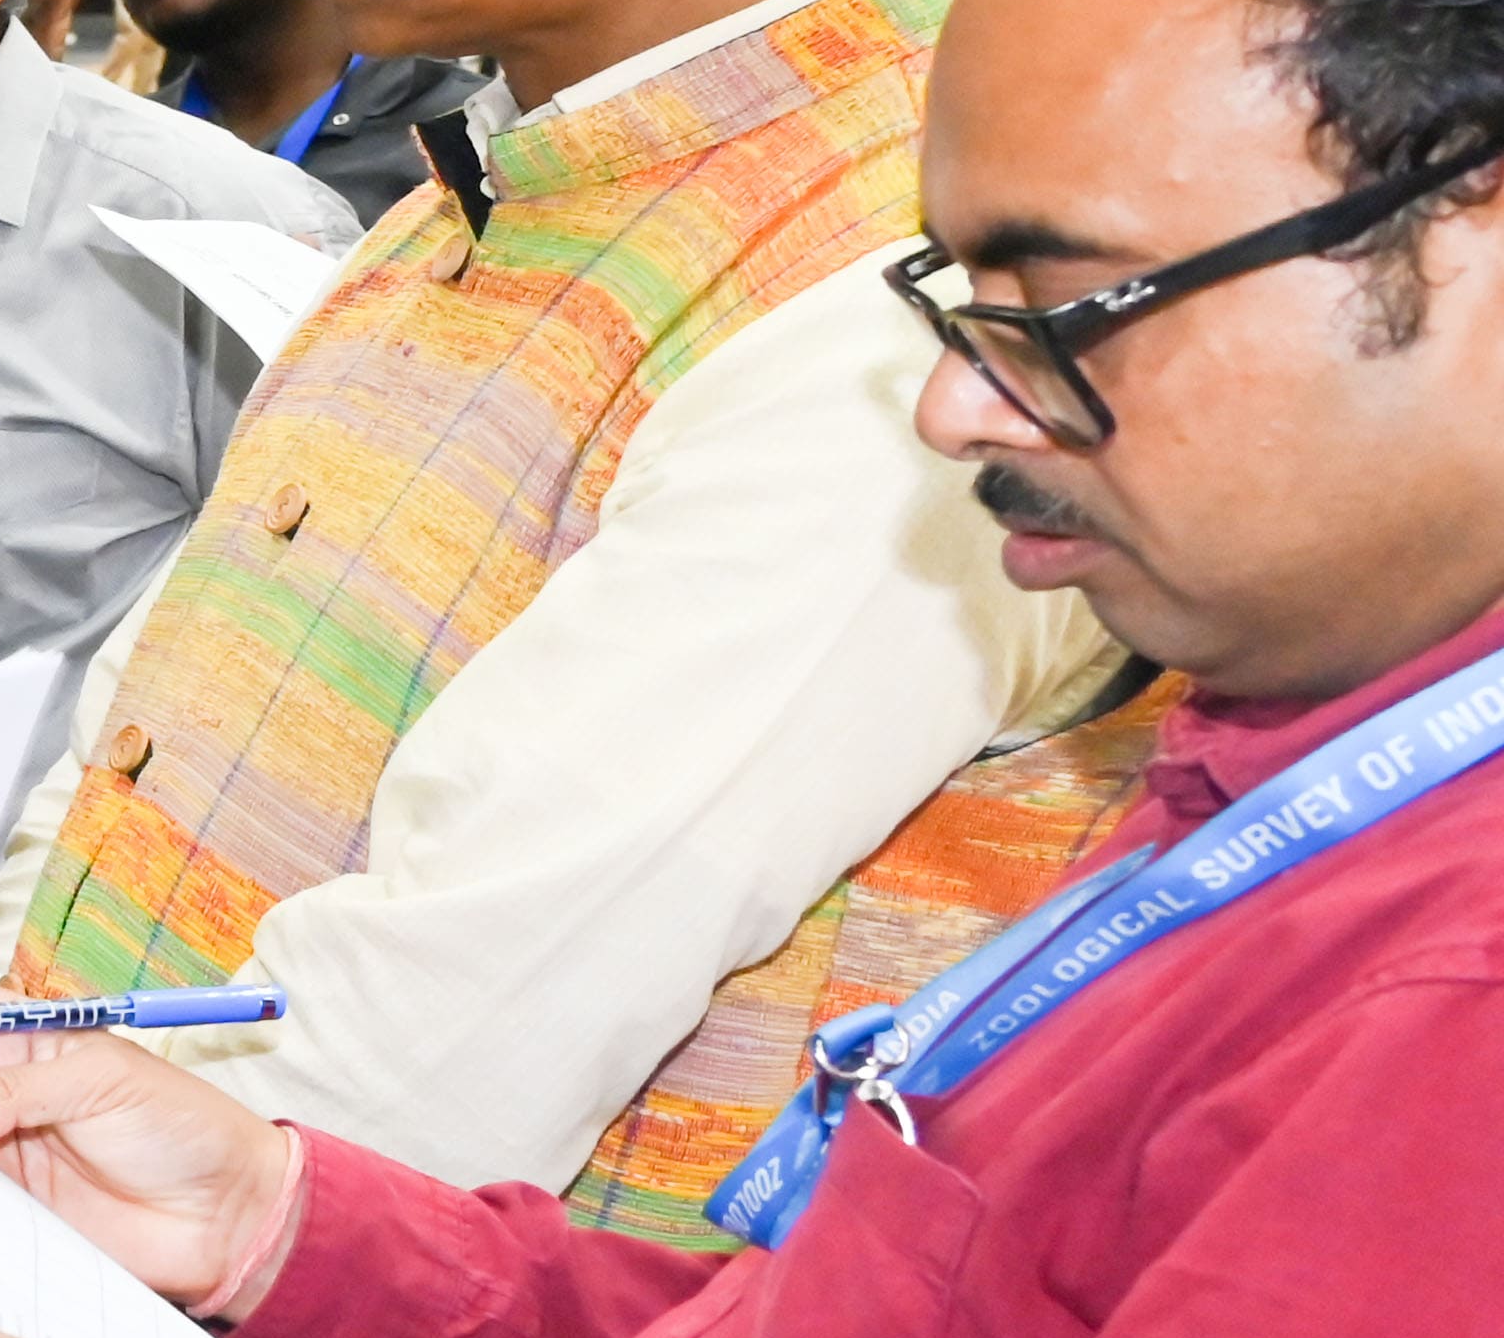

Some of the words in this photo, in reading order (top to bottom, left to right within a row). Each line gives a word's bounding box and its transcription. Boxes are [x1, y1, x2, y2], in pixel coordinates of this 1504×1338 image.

[967, 887, 1196, 1054] ZOOLOGICAL
[1189, 774, 1355, 893] SURVEY
[1356, 733, 1421, 796] OF
[1424, 675, 1504, 753] IND
[721, 1156, 784, 1233] ZOOLO
